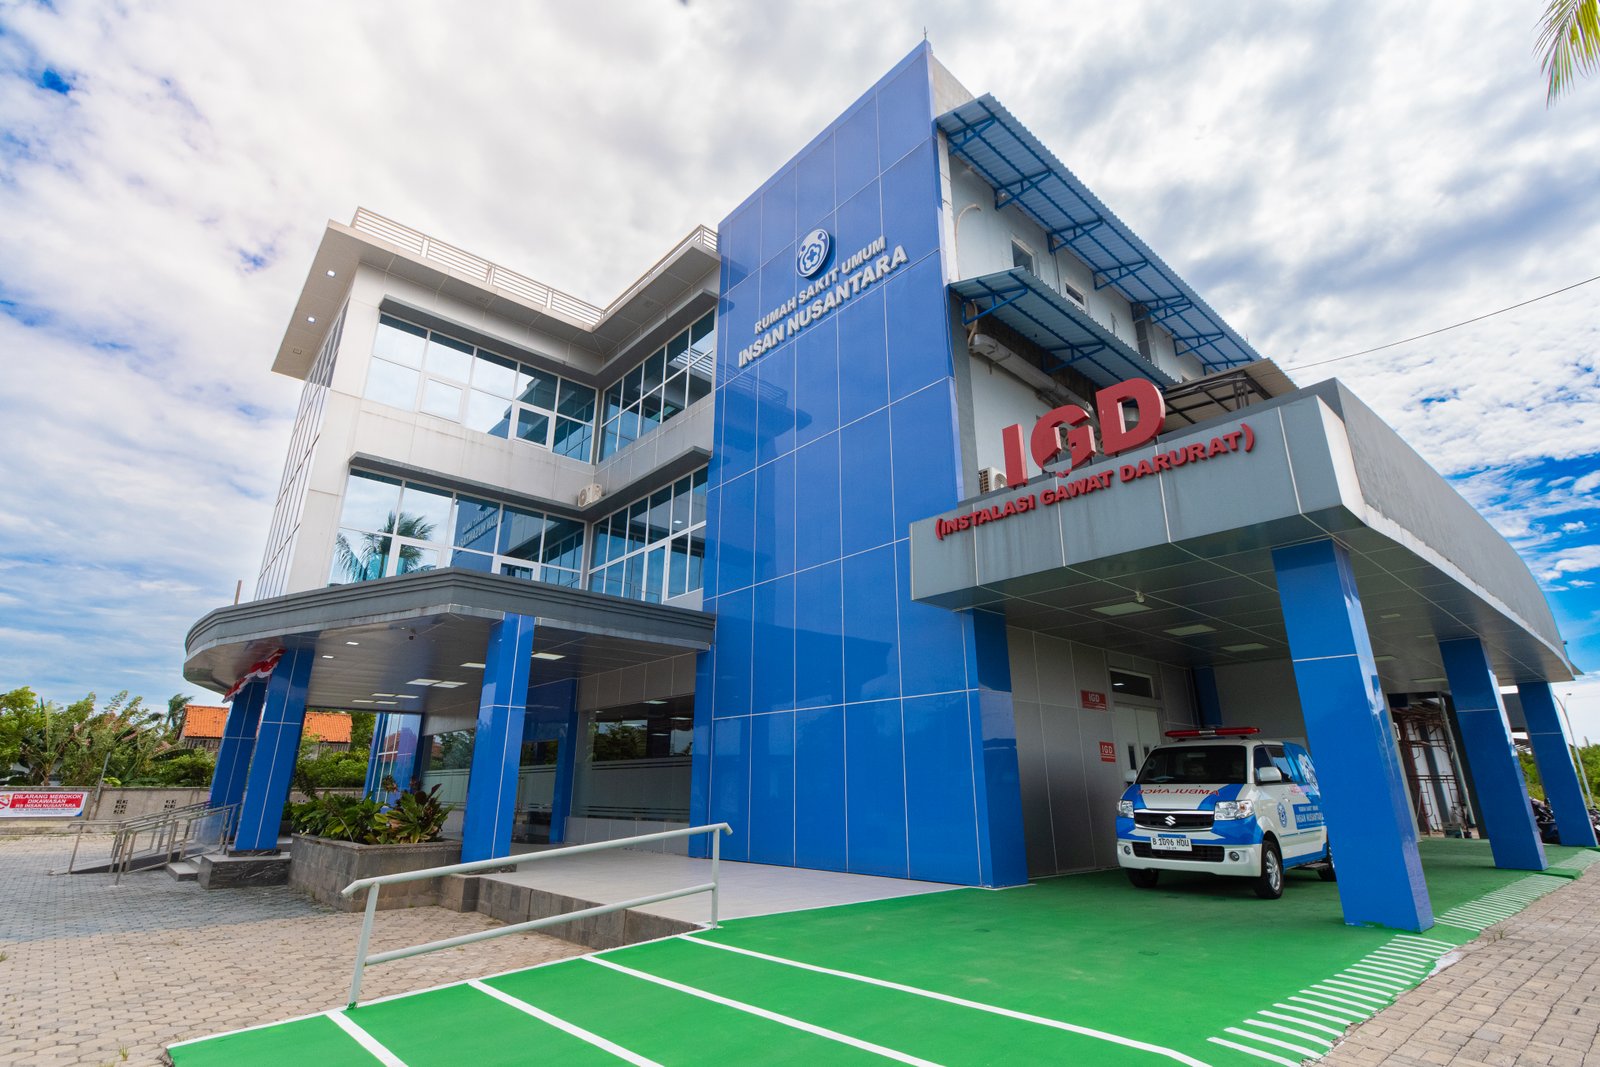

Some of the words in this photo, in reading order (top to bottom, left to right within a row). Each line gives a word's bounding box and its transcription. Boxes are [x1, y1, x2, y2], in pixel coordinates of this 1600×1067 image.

[738, 324, 785, 368] INSAN
[787, 244, 909, 337] NUSANTARA
[754, 297, 797, 334] RUMAH
[799, 267, 838, 304] SAKIT
[841, 235, 885, 274] UMUM
[934, 494, 1036, 540] (INSTALASI
[1039, 469, 1115, 506] GAWAT
[1119, 423, 1255, 483] DARURAT)
[1002, 377, 1166, 490] IGD
[1088, 693, 1100, 703] IGD
[1101, 745, 1113, 754] IGD
